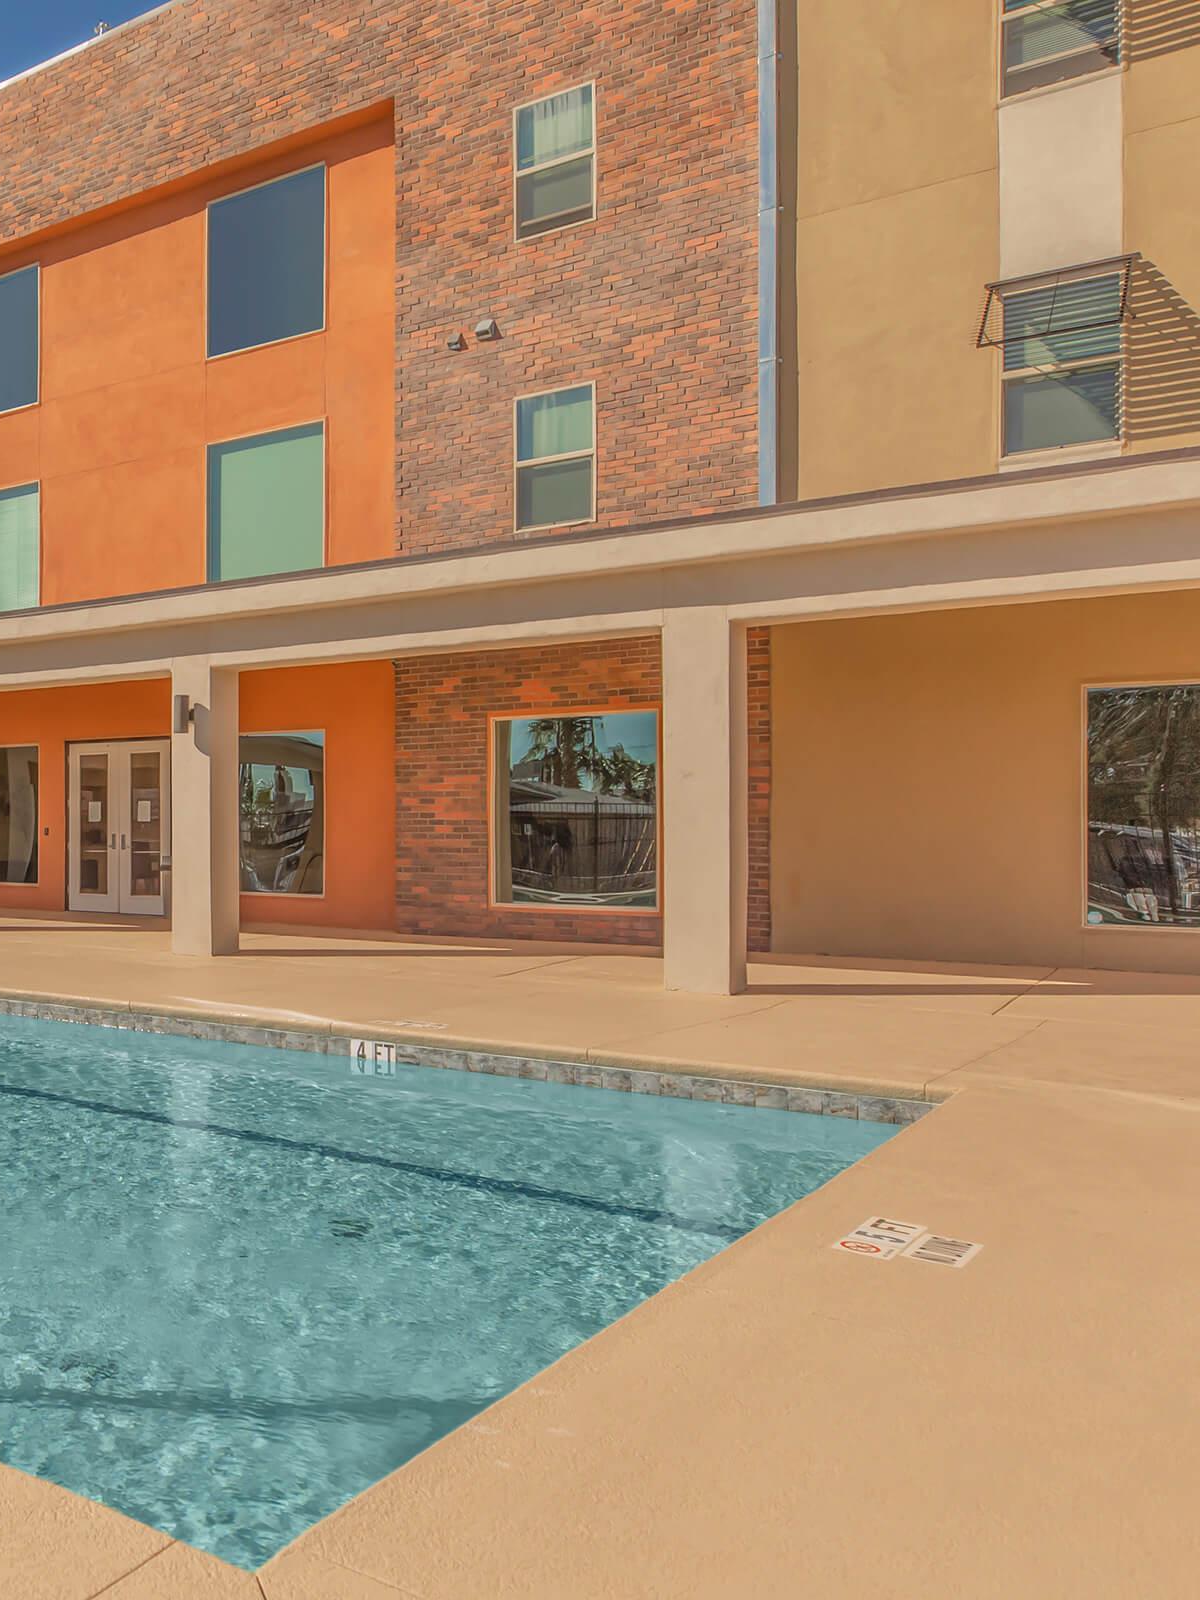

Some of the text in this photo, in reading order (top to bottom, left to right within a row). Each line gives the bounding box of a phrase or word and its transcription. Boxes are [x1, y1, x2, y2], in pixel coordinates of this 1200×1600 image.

[357, 1041, 395, 1062] 4 FT
[856, 1218, 918, 1244] 5 FT
